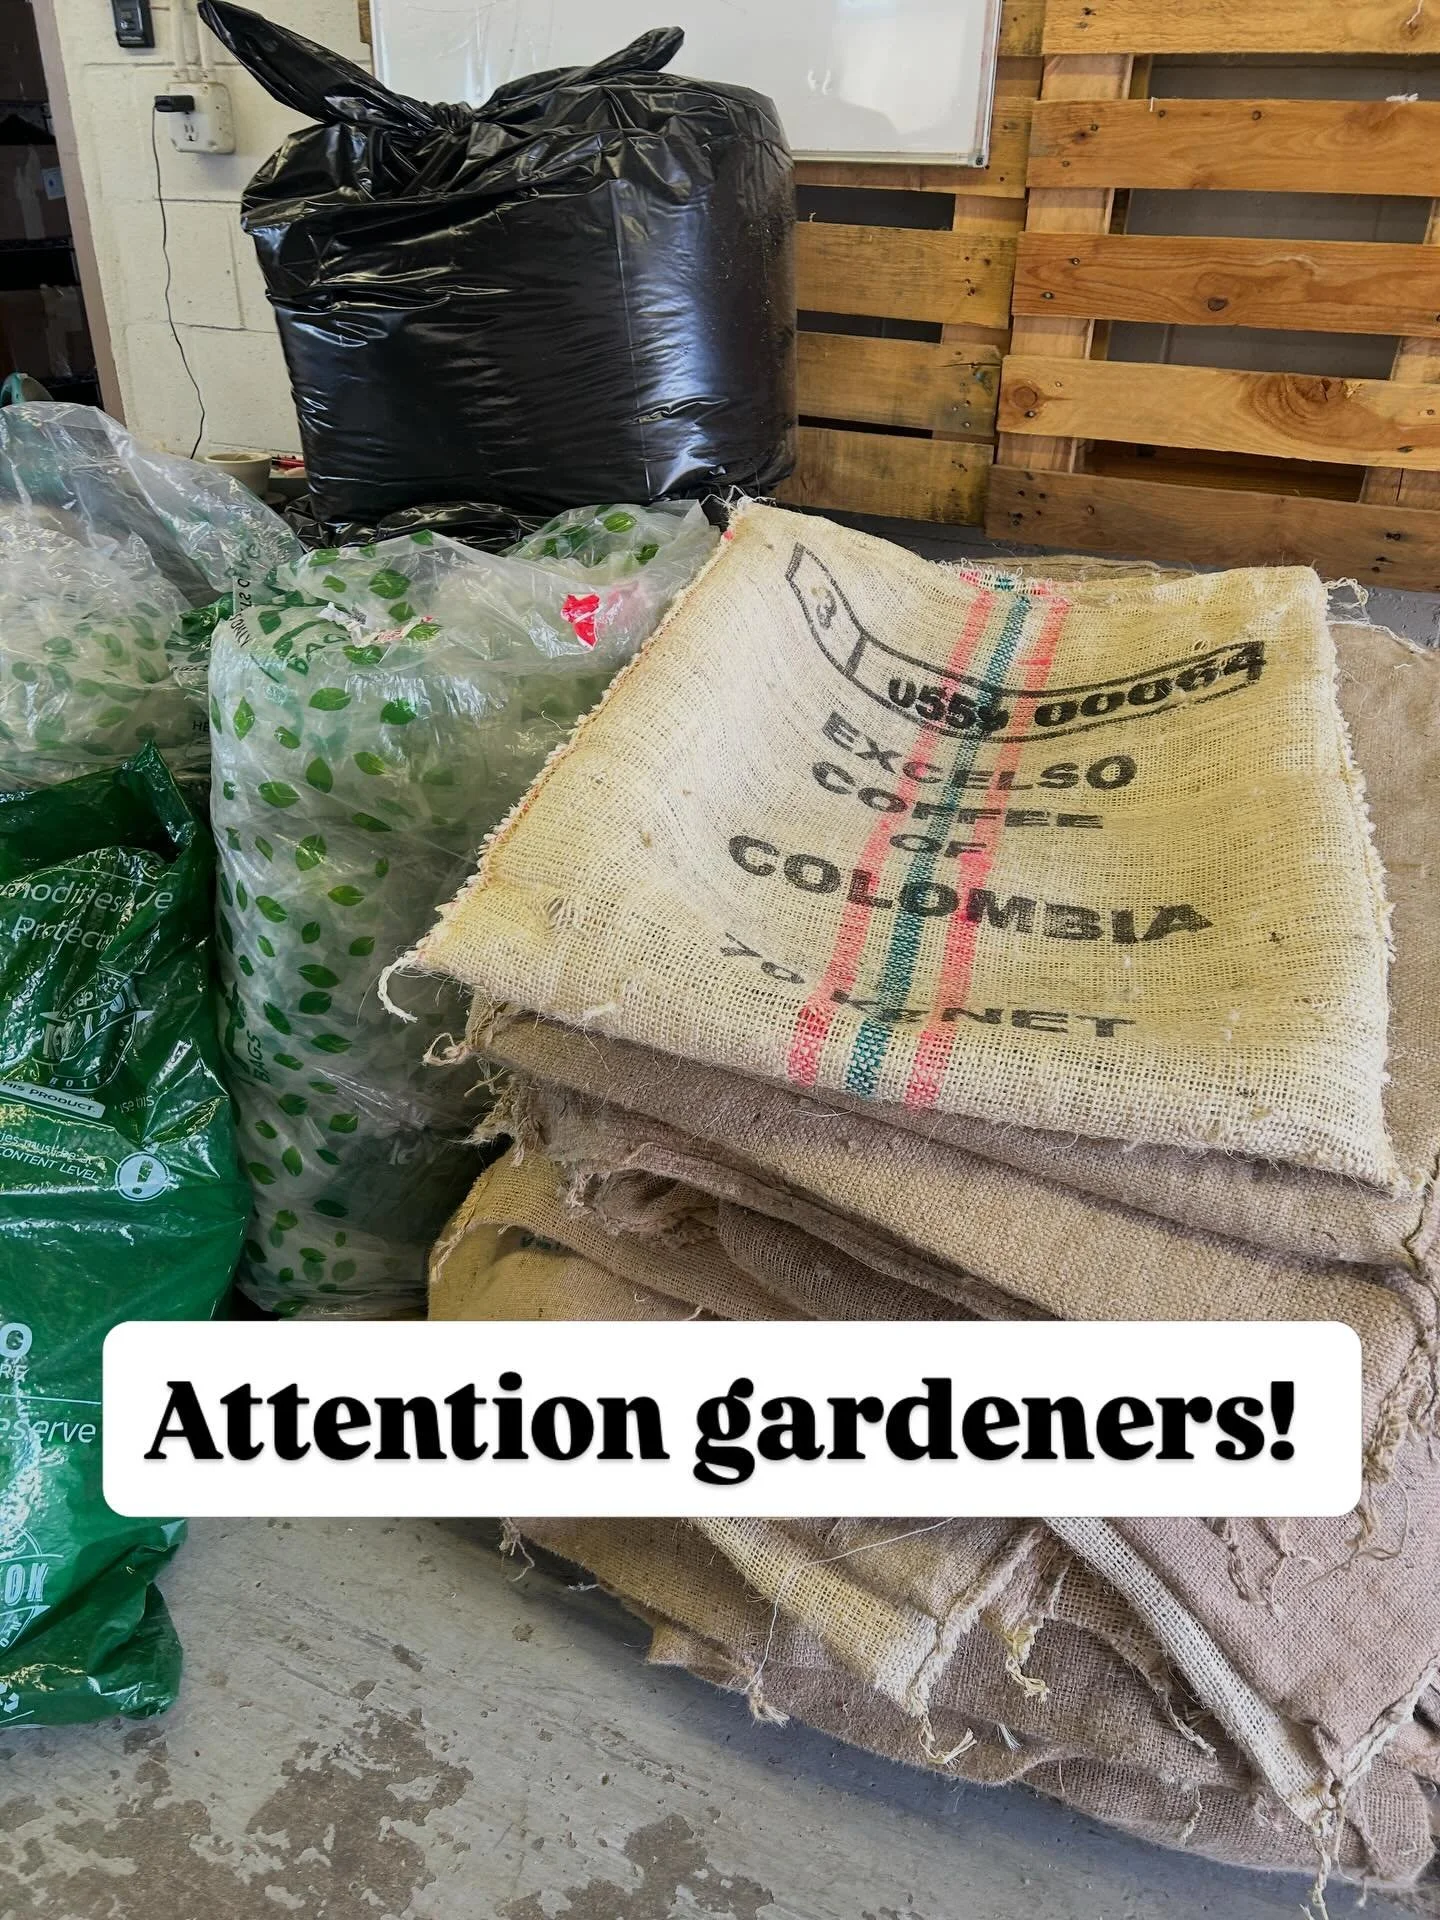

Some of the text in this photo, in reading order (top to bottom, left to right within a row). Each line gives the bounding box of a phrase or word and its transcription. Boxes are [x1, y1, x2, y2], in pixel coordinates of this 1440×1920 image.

[822, 711, 1138, 790] EXCELSO
[811, 760, 1104, 829] COFFEE
[890, 833, 987, 857] OF
[728, 834, 1214, 944] COLOMBIA
[940, 1007, 1136, 1038] NET
[0, 1146, 57, 1169] ONTENT
